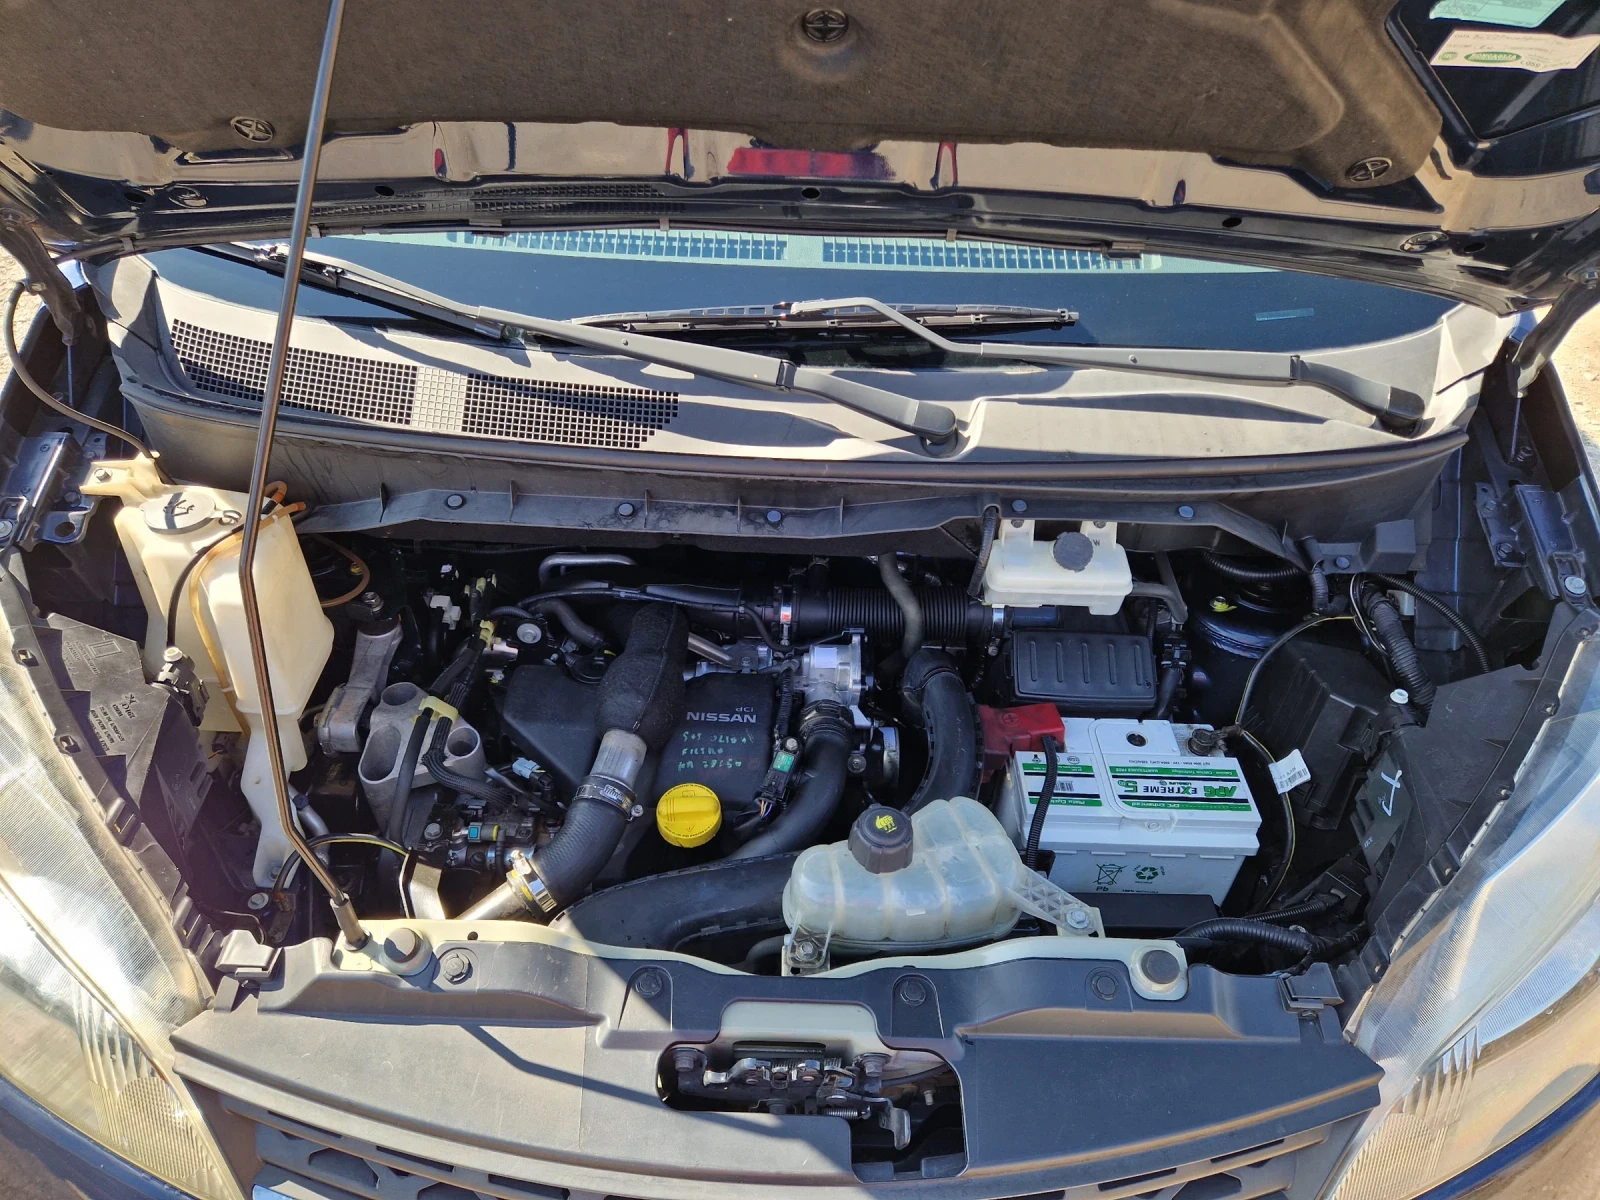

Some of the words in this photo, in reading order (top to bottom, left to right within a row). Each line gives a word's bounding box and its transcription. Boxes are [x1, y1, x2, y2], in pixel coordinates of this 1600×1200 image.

[686, 711, 757, 723] NISSAN
[1142, 785, 1198, 795] EXTREME
[1203, 785, 1237, 798] APG
